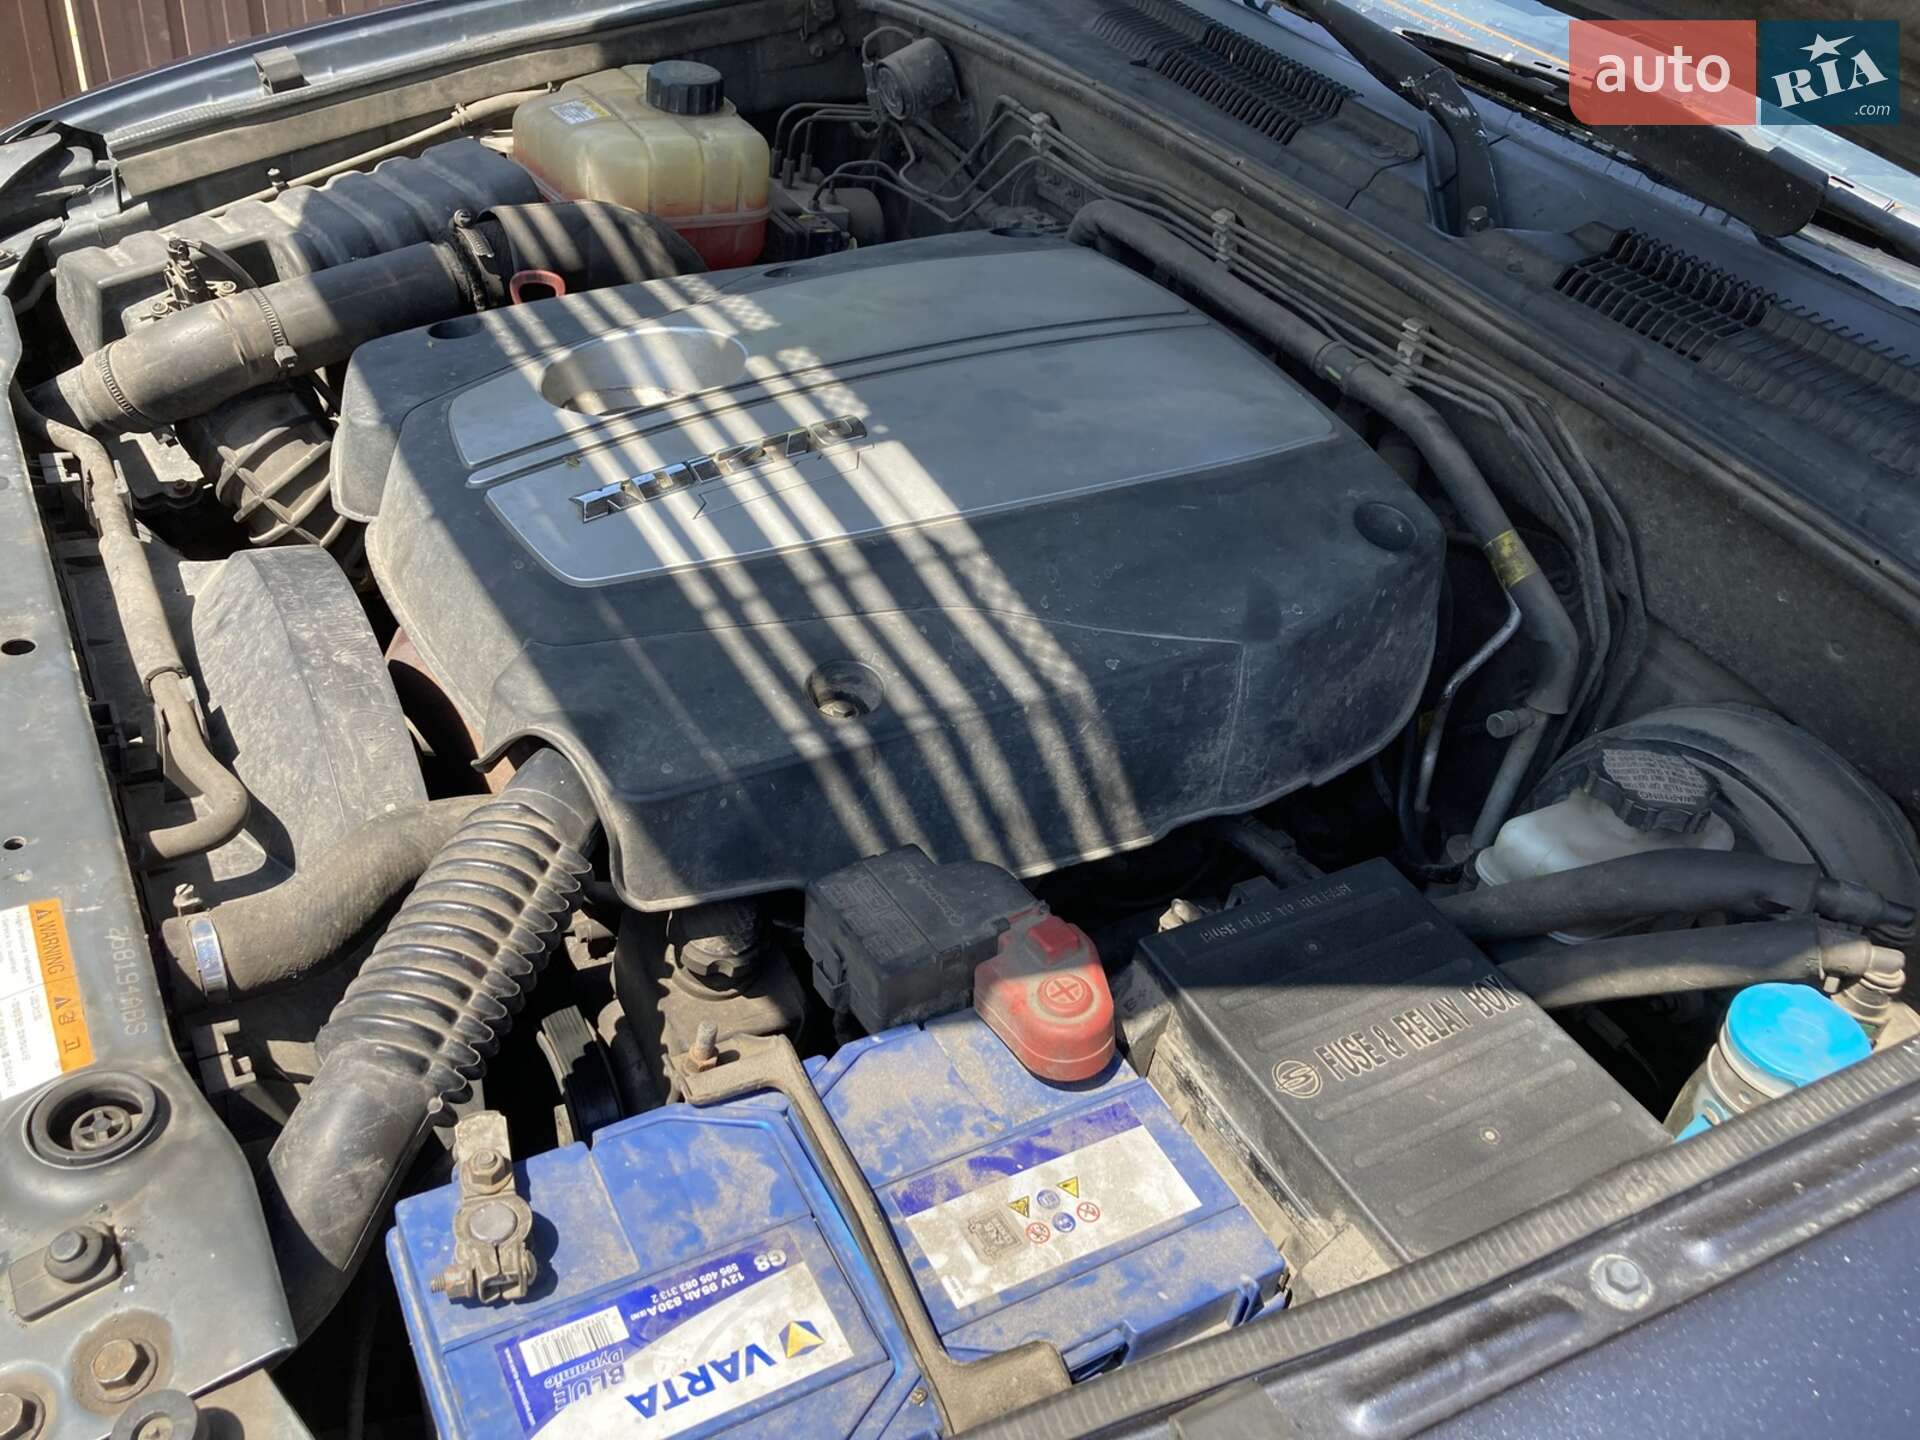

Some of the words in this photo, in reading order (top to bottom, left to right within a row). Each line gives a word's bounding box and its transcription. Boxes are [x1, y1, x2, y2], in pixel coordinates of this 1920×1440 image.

[38, 920, 65, 975] WARNING
[1314, 1032, 1388, 1081] FUSE
[1371, 1025, 1407, 1058] &
[1391, 996, 1473, 1049] RELAY
[1461, 974, 1521, 1019] BOX
[699, 1270, 718, 1284] 405
[753, 1249, 787, 1272] G8
[660, 1287, 678, 1300] 313
[721, 1271, 745, 1288] 12V
[650, 1293, 658, 1303] 2
[543, 1347, 625, 1390] Dynamic
[624, 1343, 777, 1420] VARTA
[554, 1364, 625, 1412] BLUE
